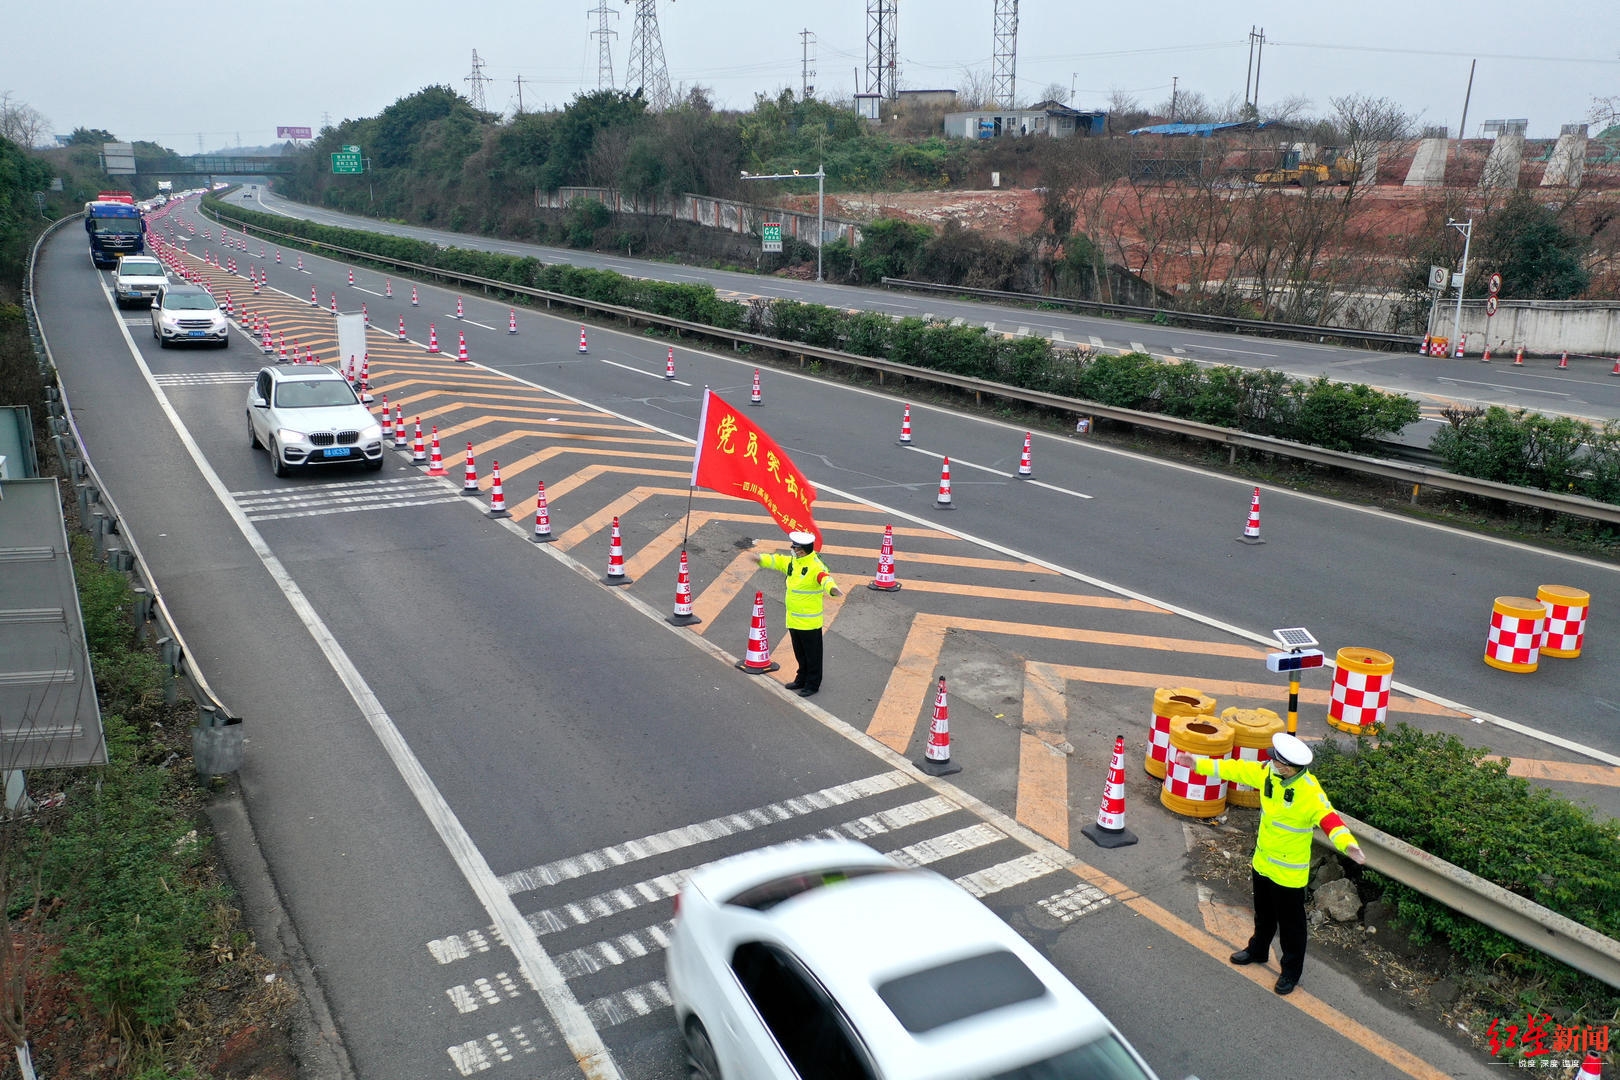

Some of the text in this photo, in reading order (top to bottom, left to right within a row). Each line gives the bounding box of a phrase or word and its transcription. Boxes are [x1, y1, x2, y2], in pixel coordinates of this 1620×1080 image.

[764, 227, 779, 235] G42
[716, 413, 811, 513] 党员突击队
